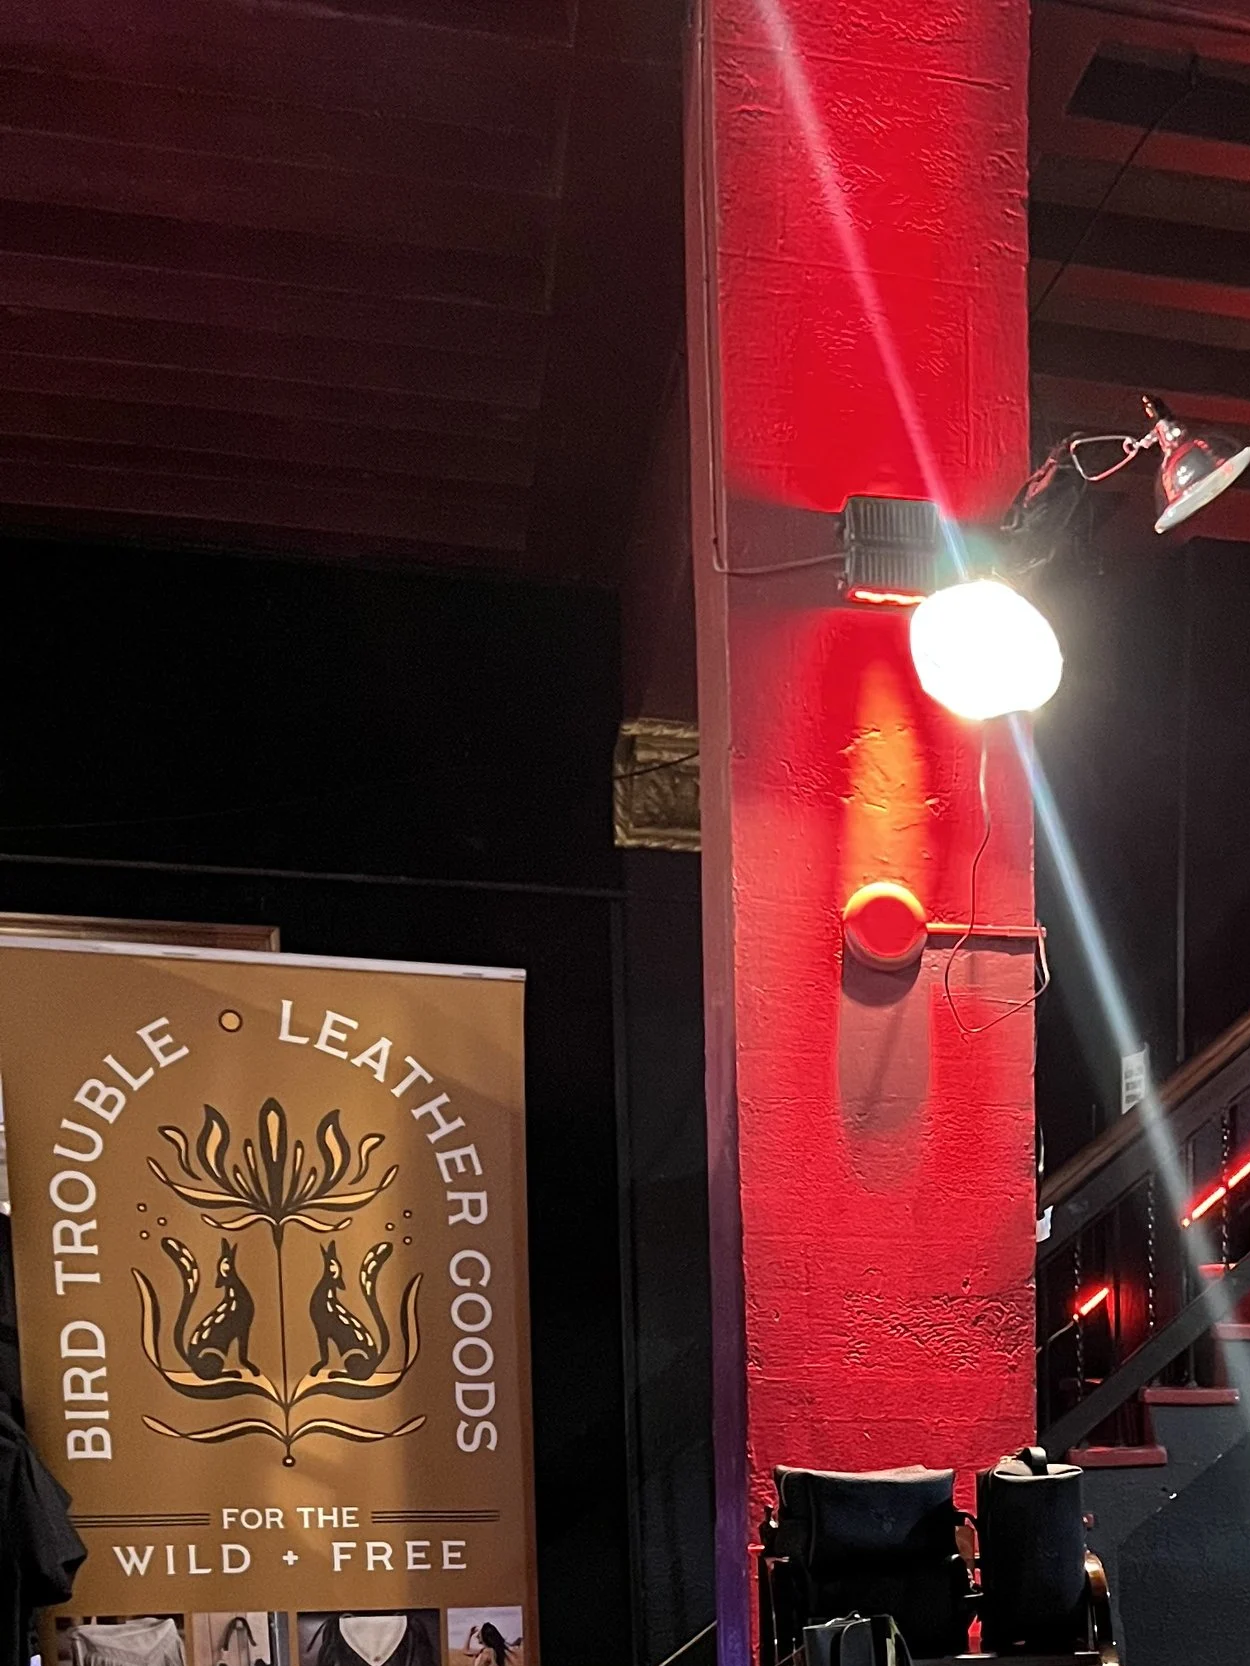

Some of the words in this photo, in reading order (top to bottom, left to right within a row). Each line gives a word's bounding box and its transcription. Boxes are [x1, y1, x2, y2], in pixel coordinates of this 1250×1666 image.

[49, 1017, 190, 1296] TROUBLE
[278, 999, 489, 1227] LEATHER
[60, 1320, 112, 1460] BIRD
[448, 1249, 498, 1454] GOODS
[112, 1543, 251, 1576] WILD
[331, 1540, 467, 1572] FREE
[222, 1507, 285, 1530] FOR
[296, 1507, 360, 1529] THE
